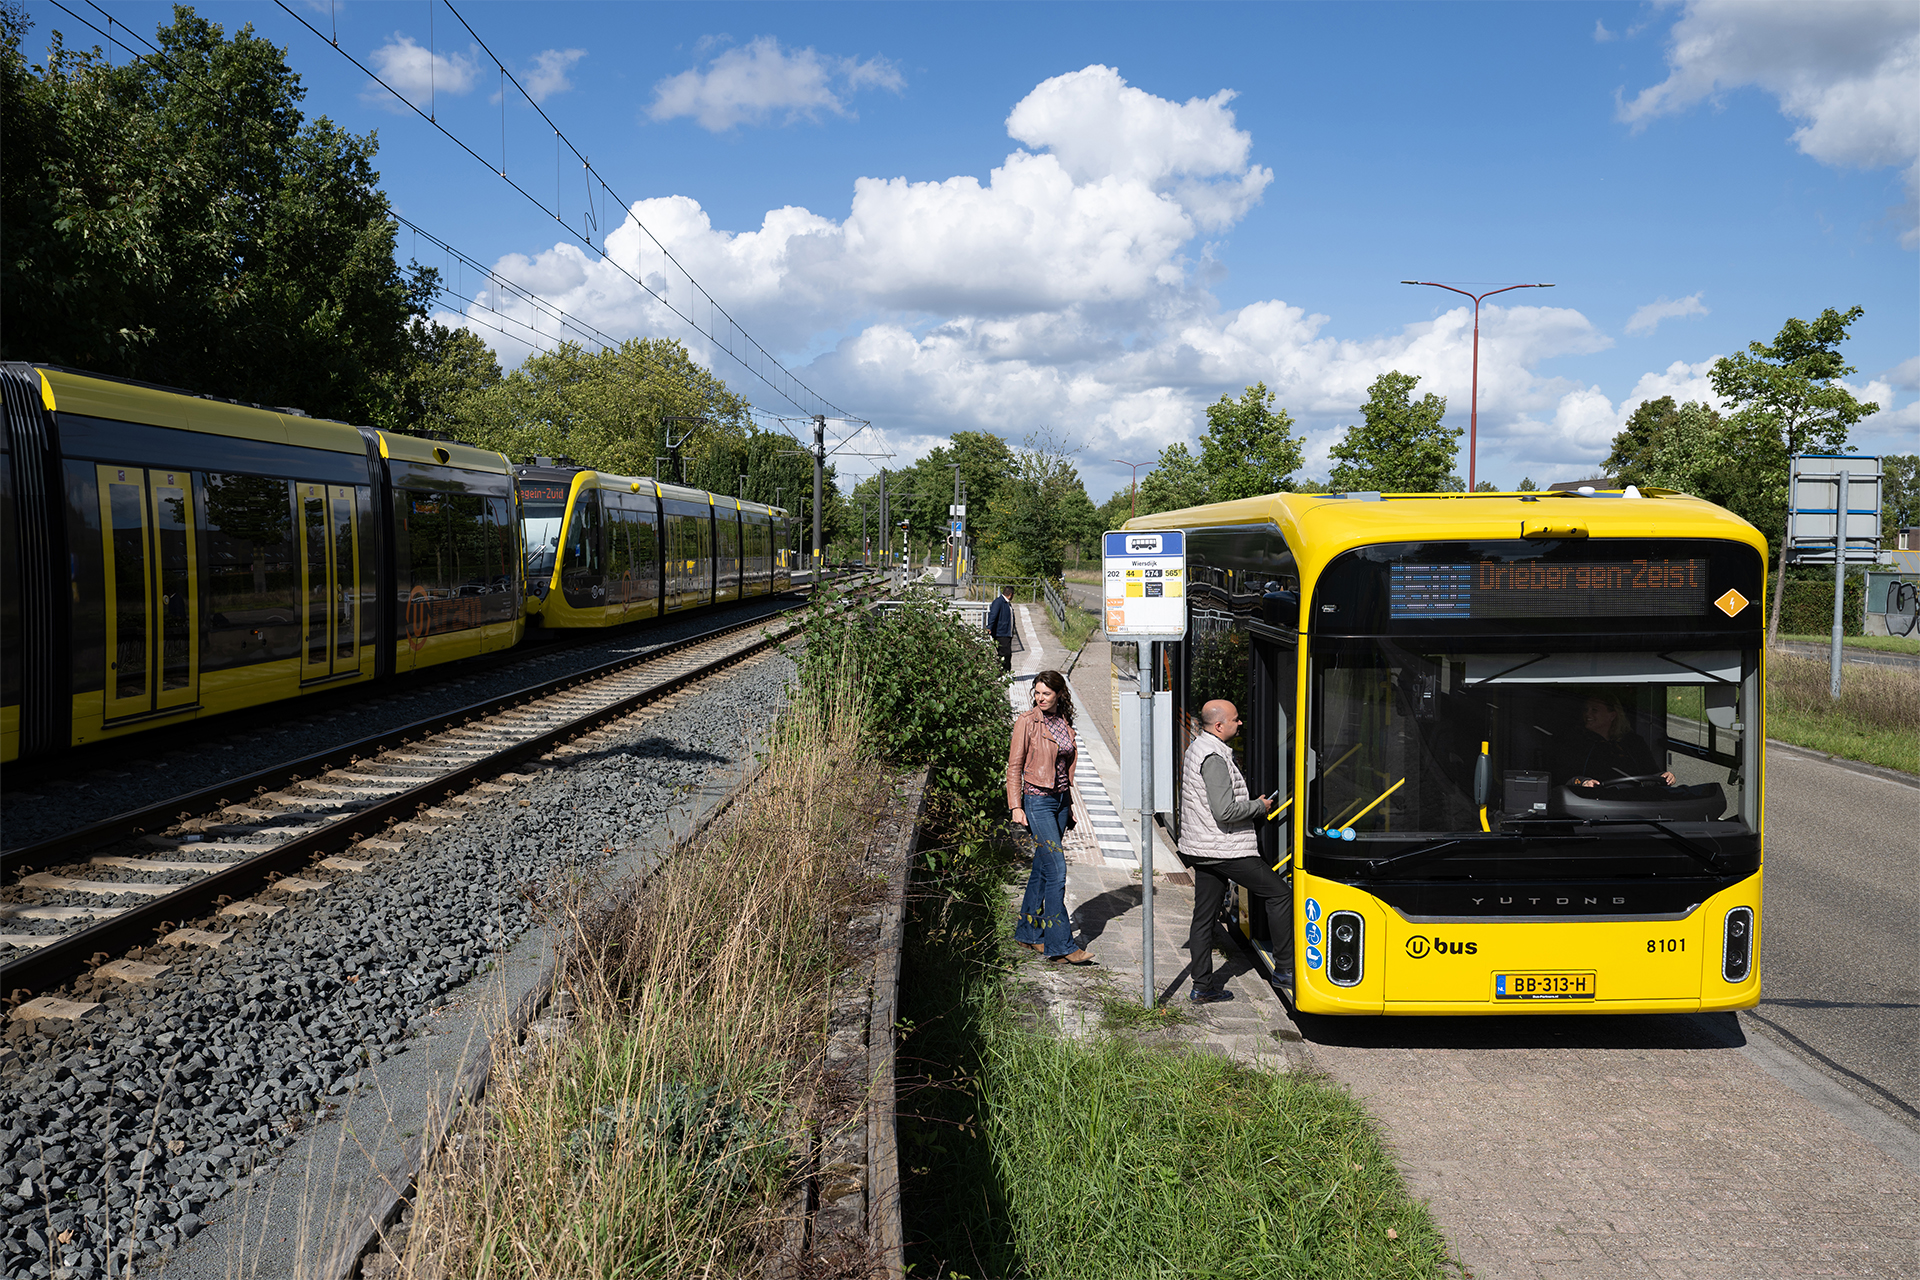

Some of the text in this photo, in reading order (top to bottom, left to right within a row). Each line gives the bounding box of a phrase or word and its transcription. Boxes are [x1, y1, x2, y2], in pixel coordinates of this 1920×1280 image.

[1107, 570, 1120, 578] 202
[1145, 569, 1159, 577] 474
[1165, 569, 1178, 577] 565
[1479, 558, 1698, 590] Driebergen-Zeist
[1472, 896, 1625, 905] YUTONG
[1434, 937, 1478, 955] bus
[1646, 938, 1685, 953] 8101
[1514, 977, 1586, 992] BB-313-H
